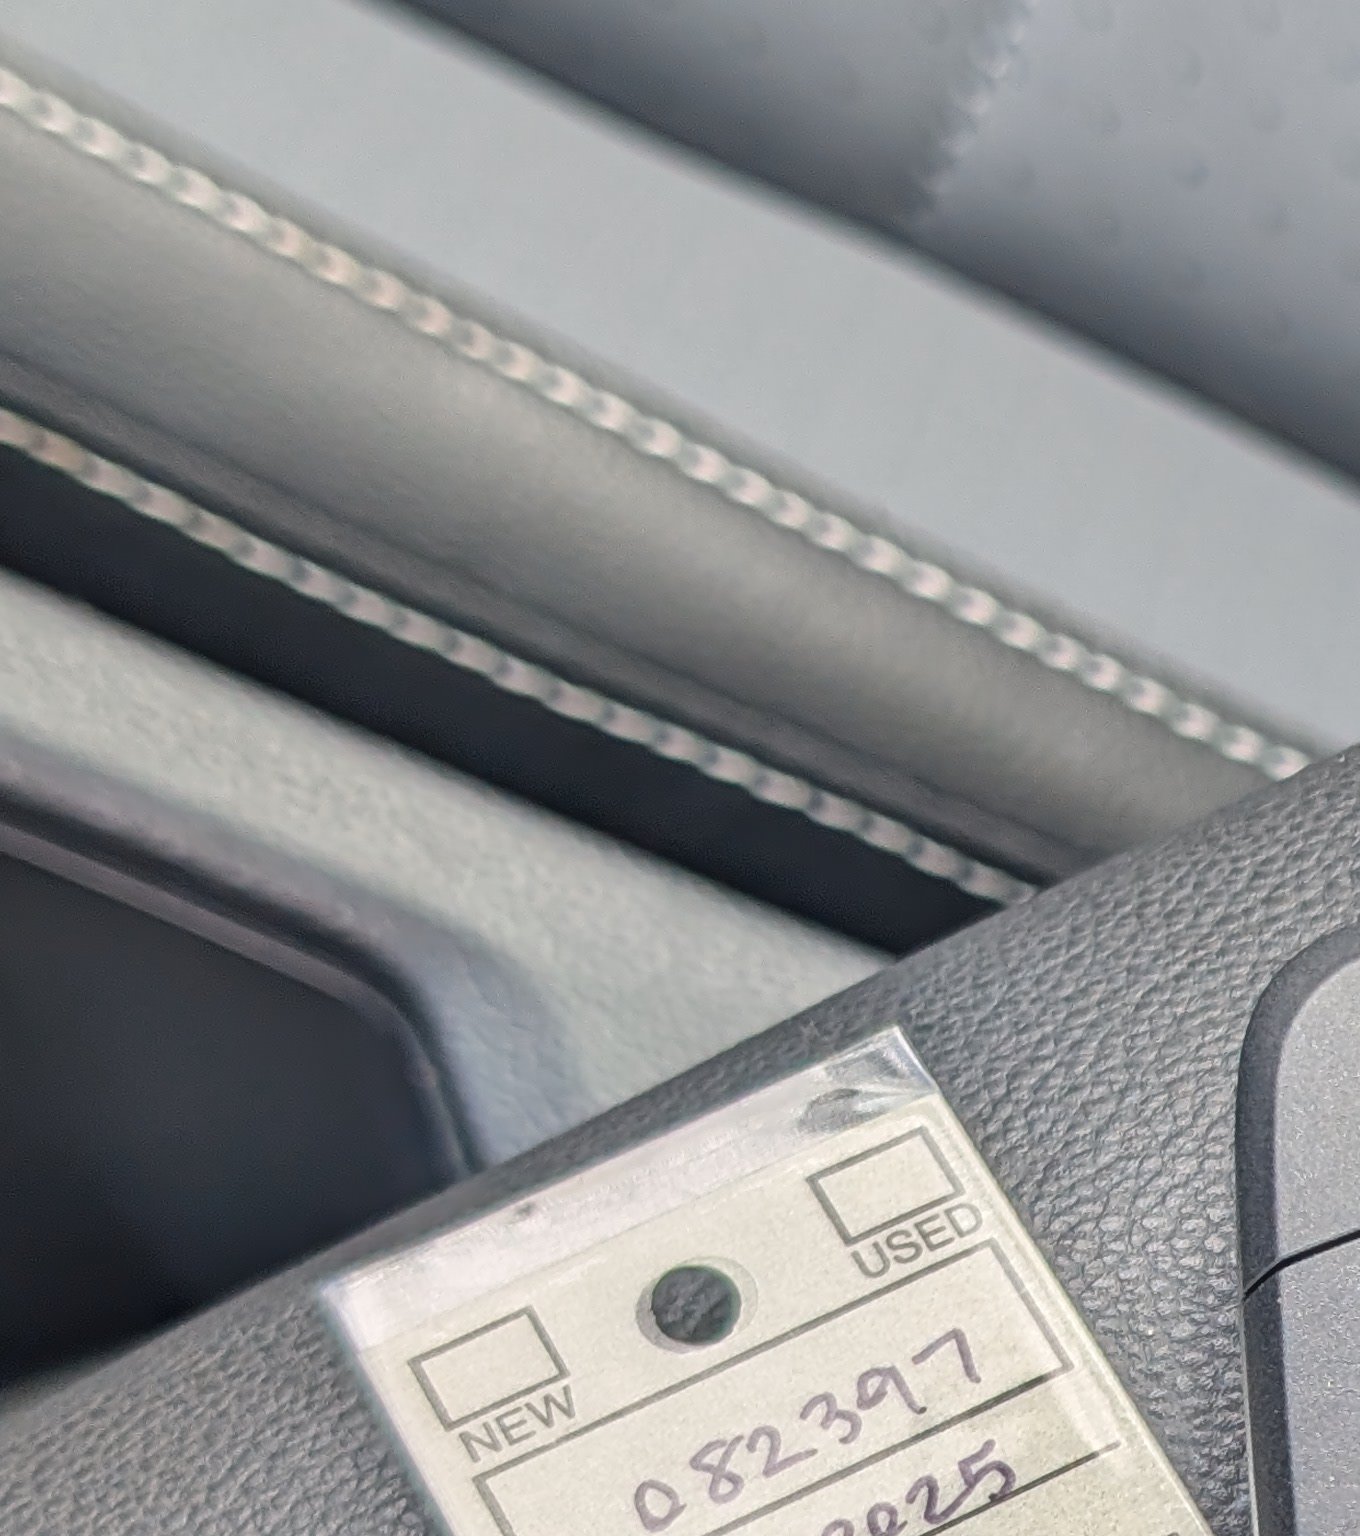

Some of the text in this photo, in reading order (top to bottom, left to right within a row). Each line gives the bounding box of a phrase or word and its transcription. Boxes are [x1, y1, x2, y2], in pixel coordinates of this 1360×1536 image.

[851, 1203, 984, 1279] USED
[459, 1386, 575, 1462] NEW
[634, 1329, 980, 1533] 082397
